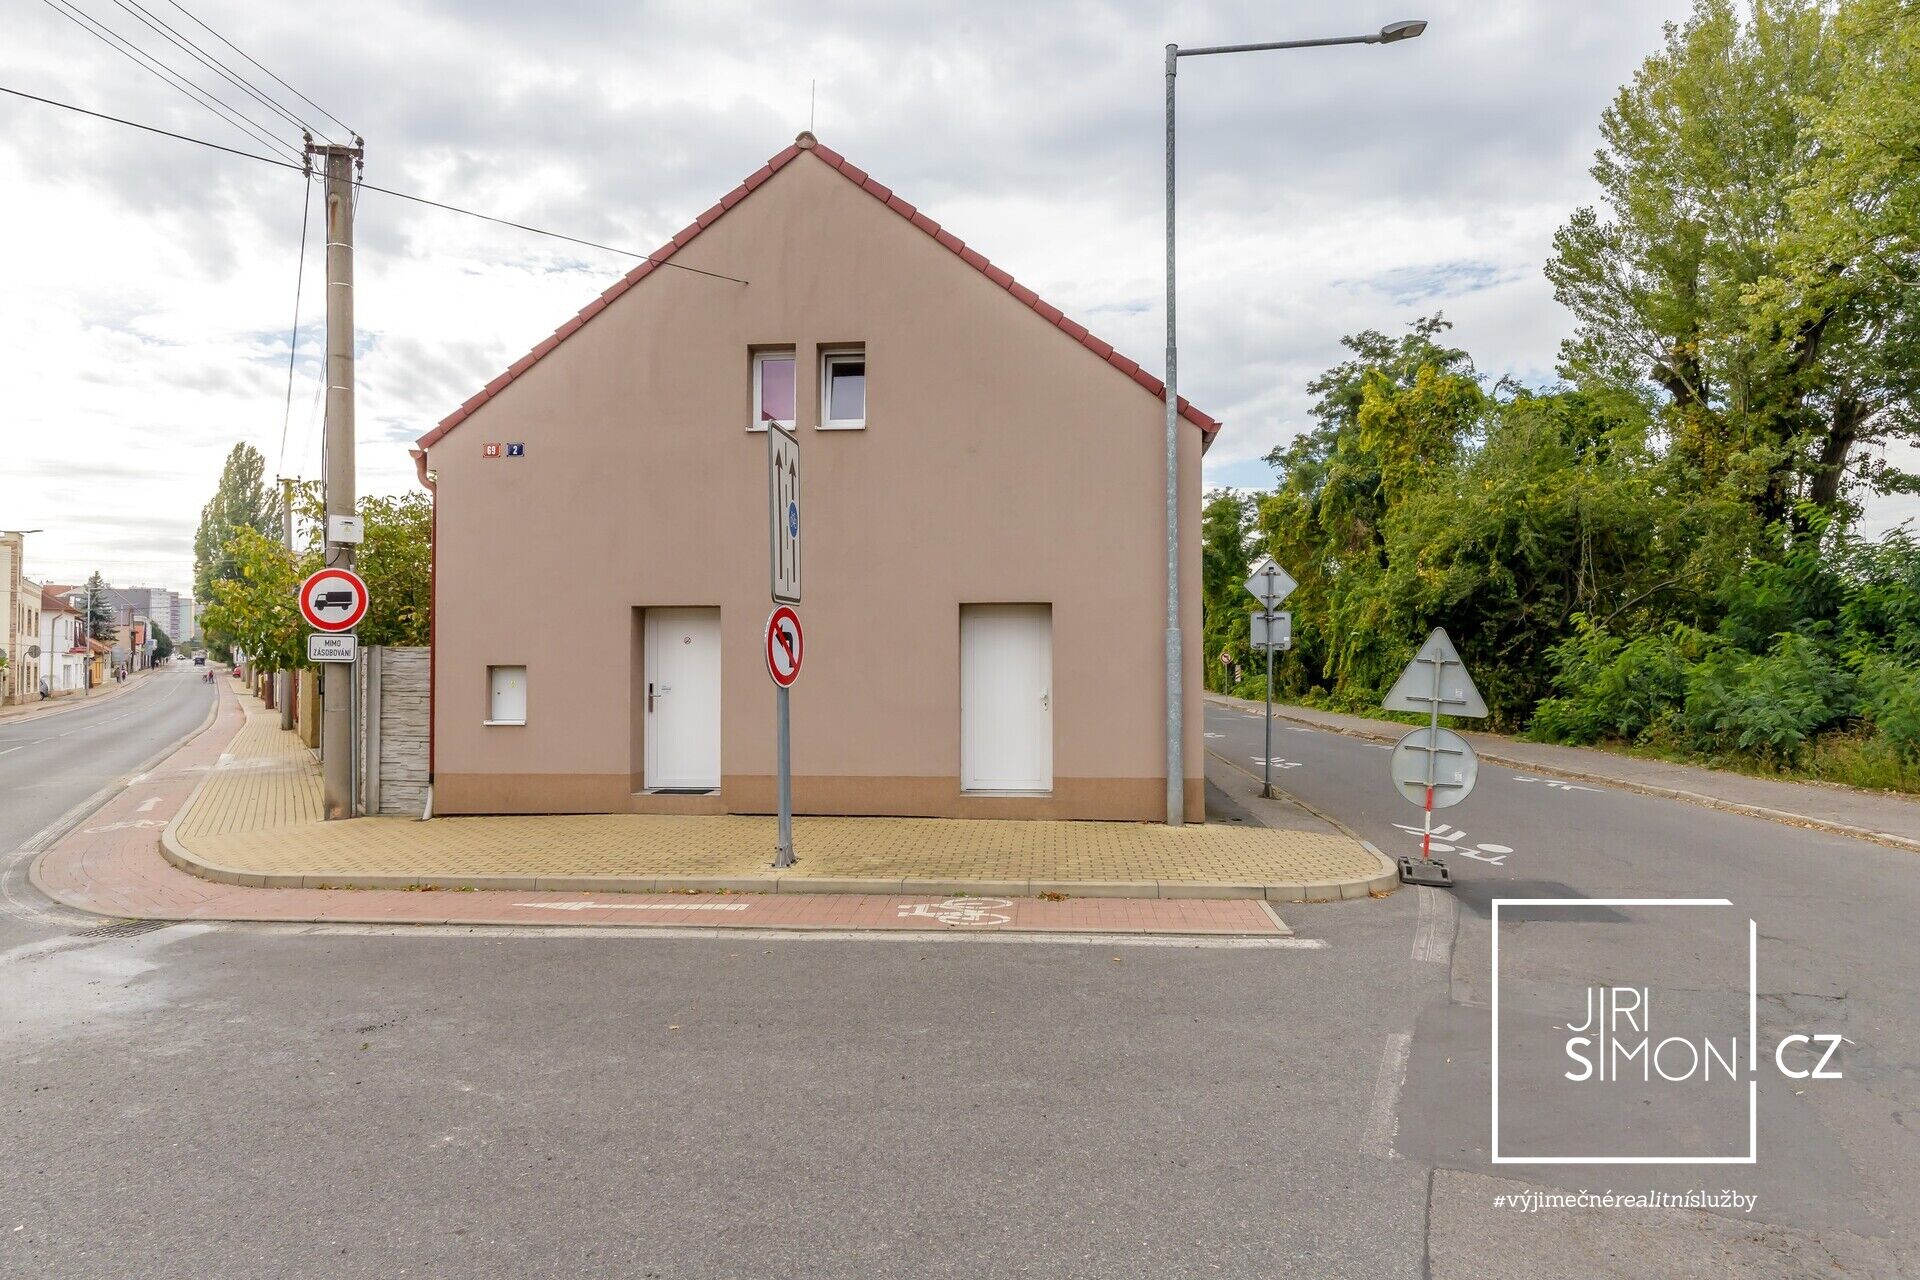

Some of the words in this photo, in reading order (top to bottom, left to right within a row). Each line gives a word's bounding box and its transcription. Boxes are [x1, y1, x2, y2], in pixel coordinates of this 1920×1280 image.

[487, 445, 496, 455] 69
[512, 445, 518, 455] 2
[313, 647, 352, 656] ZÁSOBOVÁNÍ
